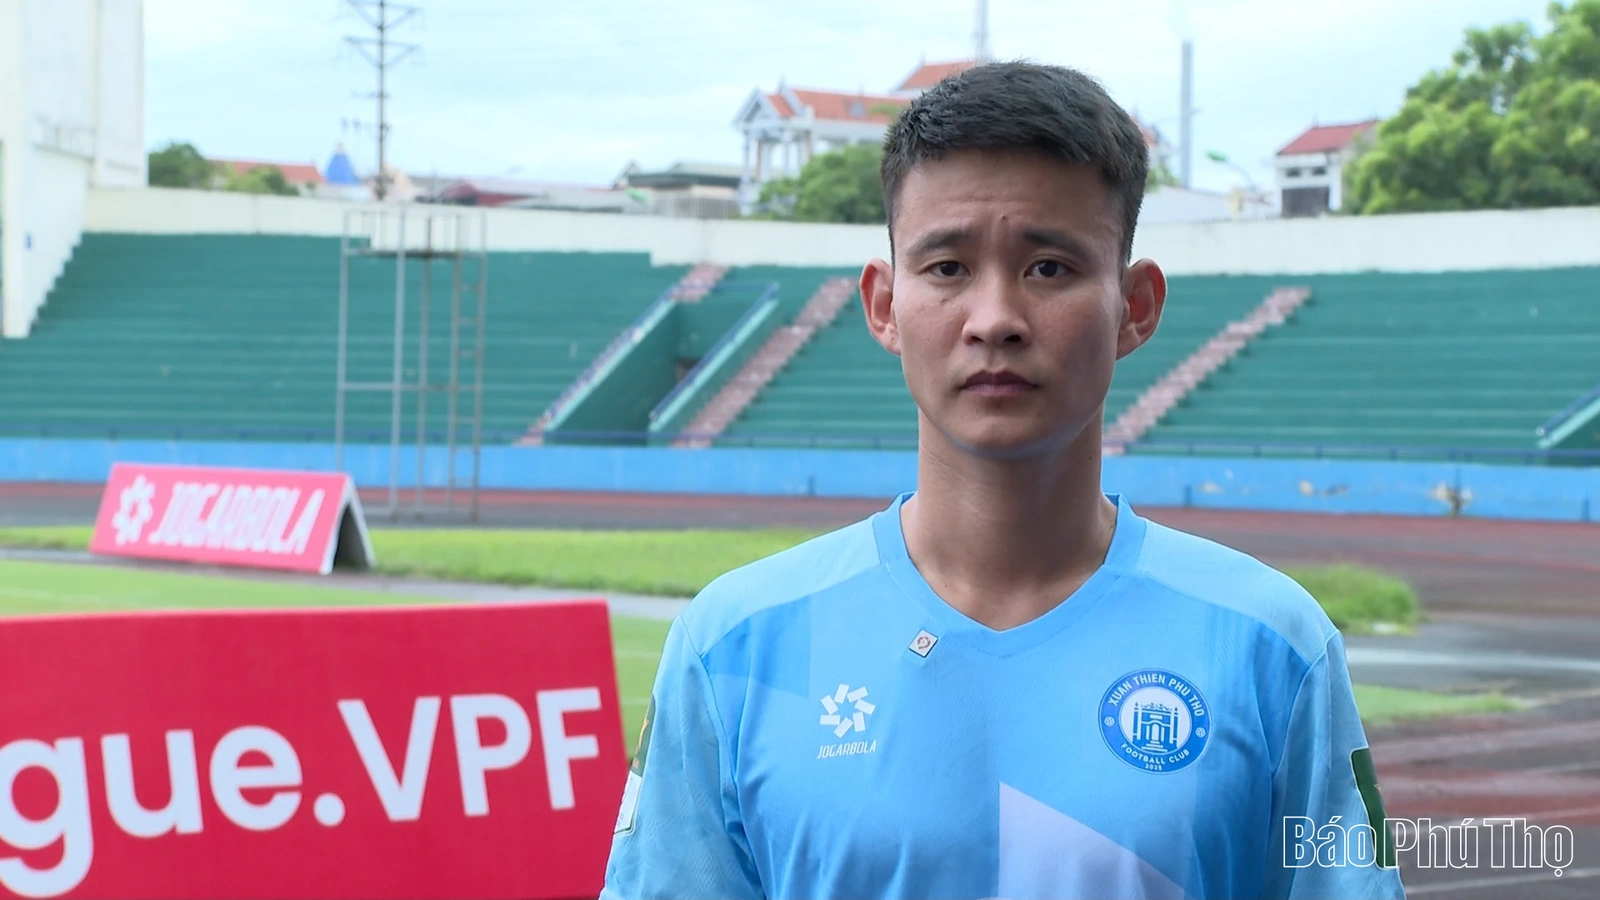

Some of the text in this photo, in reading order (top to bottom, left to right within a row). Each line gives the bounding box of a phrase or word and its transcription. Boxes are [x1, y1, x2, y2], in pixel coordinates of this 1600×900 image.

[148, 481, 325, 555] JOGARBOLA
[1108, 673, 1205, 717] XUAN THIEN PHU THO
[816, 739, 877, 759] JOGARBOLA
[1121, 742, 1190, 764] FOOTBALL CLUB
